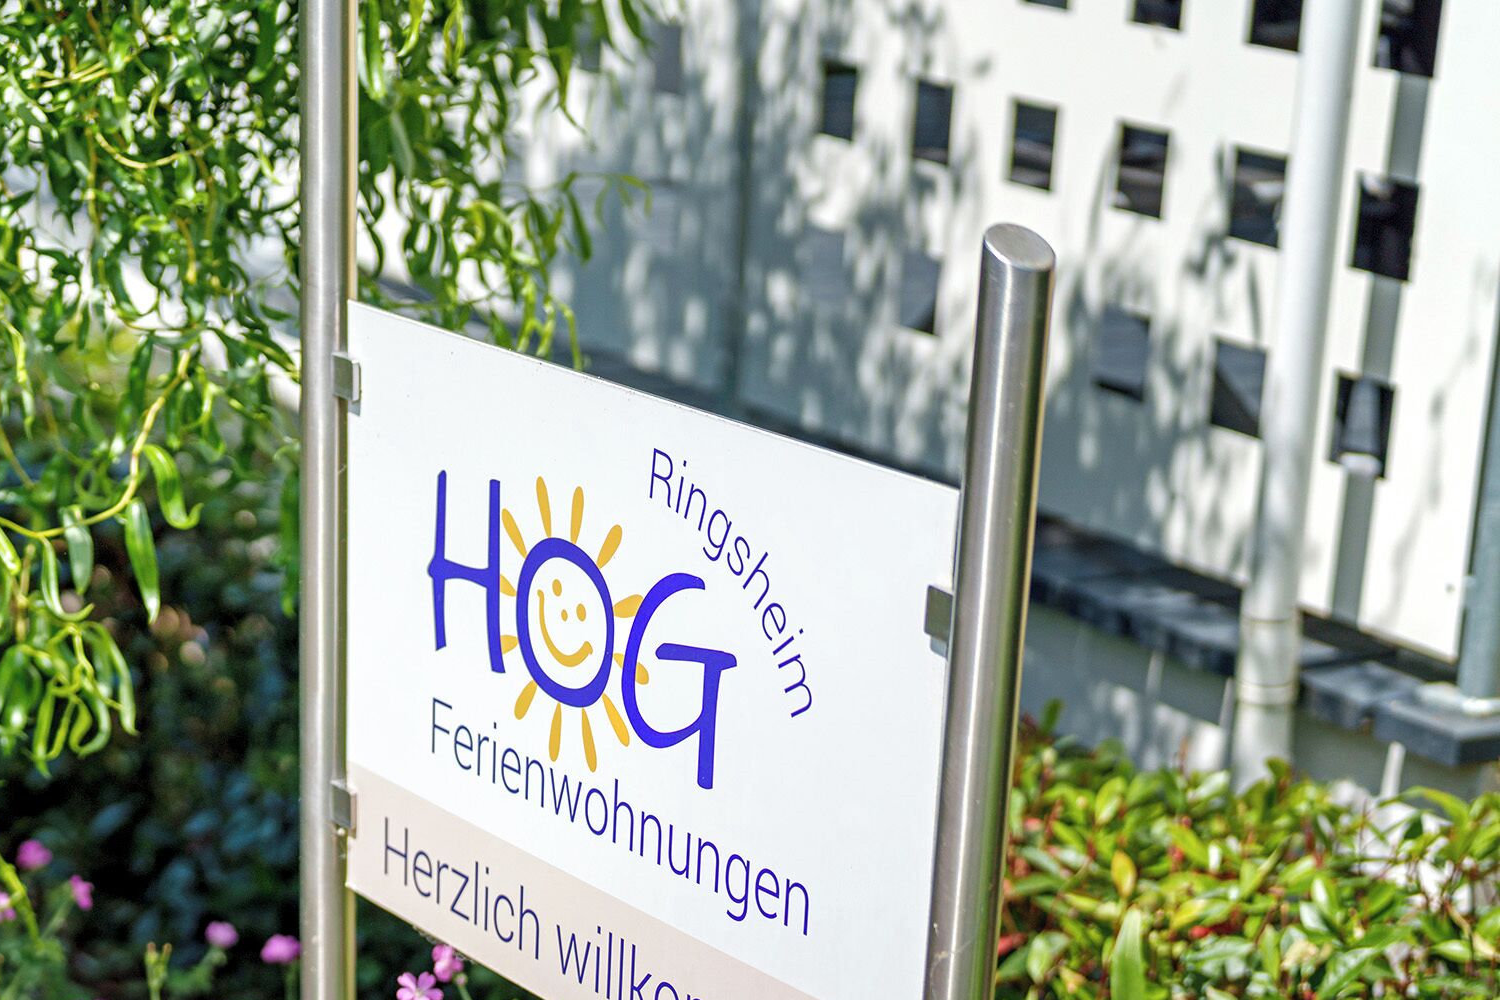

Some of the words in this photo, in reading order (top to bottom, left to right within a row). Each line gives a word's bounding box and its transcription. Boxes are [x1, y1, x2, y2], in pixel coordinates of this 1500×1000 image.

[428, 470, 738, 790] HOG
[648, 448, 813, 718] Ringsheim
[383, 816, 540, 961] Herzlich
[431, 697, 810, 936] Ferienwohnungen
